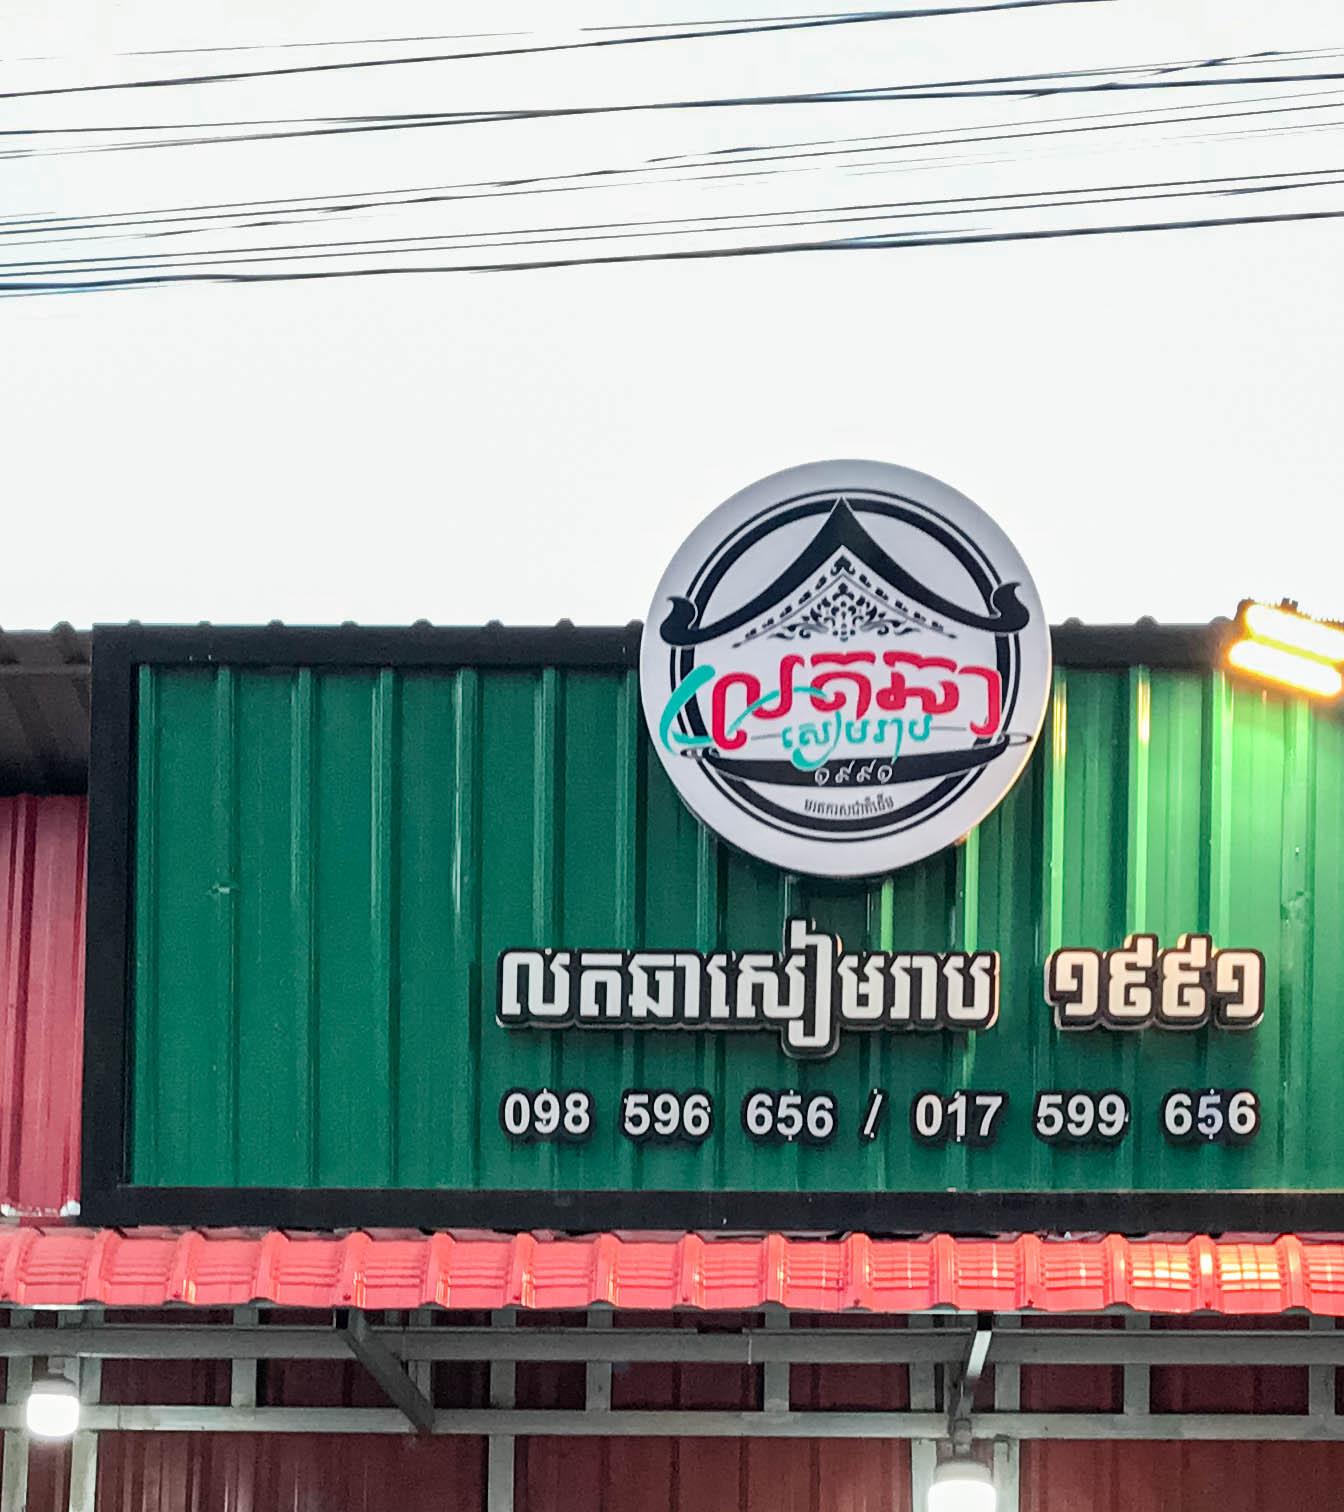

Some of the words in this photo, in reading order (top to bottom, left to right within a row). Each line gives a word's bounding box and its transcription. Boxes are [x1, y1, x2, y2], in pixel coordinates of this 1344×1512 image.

[814, 759, 894, 786] ១៩៩១
[499, 918, 999, 1052] លតឆាសៀមរាប
[1051, 934, 1262, 1023] ១៩៩១
[502, 1091, 592, 1139] 098
[622, 1092, 712, 1138] 596
[744, 1091, 835, 1141] 656
[914, 1091, 1004, 1141] 017
[1035, 1092, 1129, 1138] 599
[1163, 1090, 1258, 1138] 656
